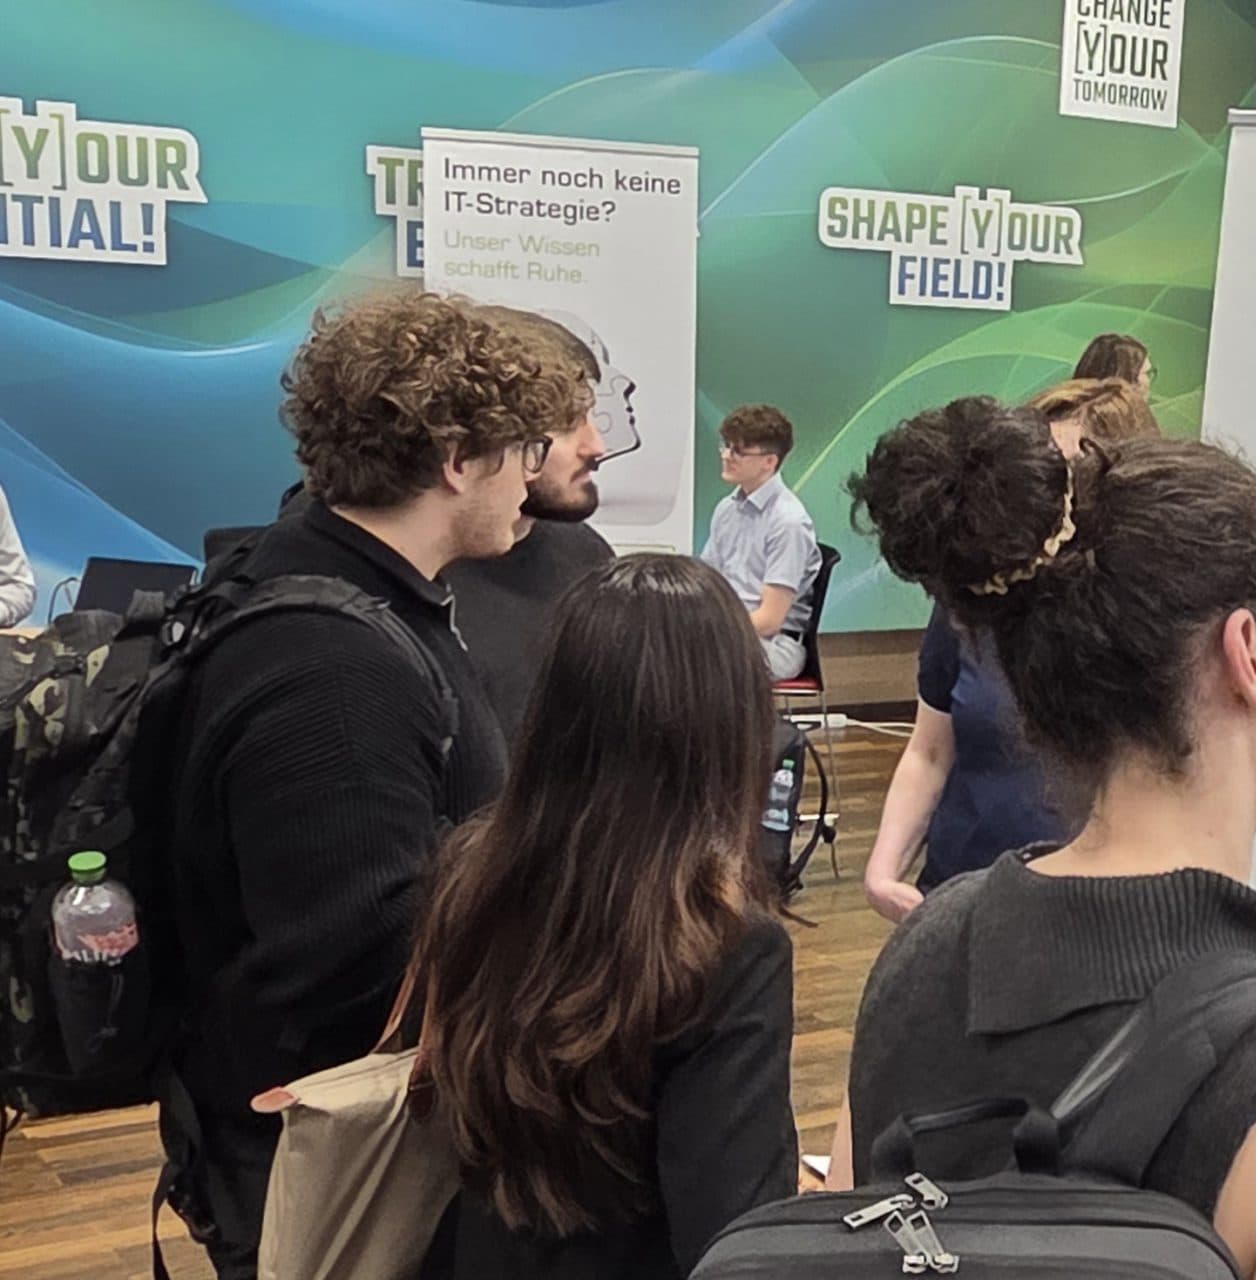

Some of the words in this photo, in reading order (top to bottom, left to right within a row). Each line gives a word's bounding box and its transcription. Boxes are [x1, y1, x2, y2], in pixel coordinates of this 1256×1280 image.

[1075, 20, 1169, 81] [Y]OUR
[1073, 78, 1168, 111] TOMORROW
[444, 157, 530, 184] Immer
[541, 168, 604, 189] noch
[614, 169, 681, 194] keine
[444, 190, 616, 226] IT-Strategie?
[827, 196, 949, 246] SHAPE
[960, 195, 1074, 257] [Y]OUR
[444, 230, 510, 251] Unser
[518, 234, 600, 257] Wissen
[444, 259, 520, 280] schafft
[898, 255, 1006, 302] FIELD!
